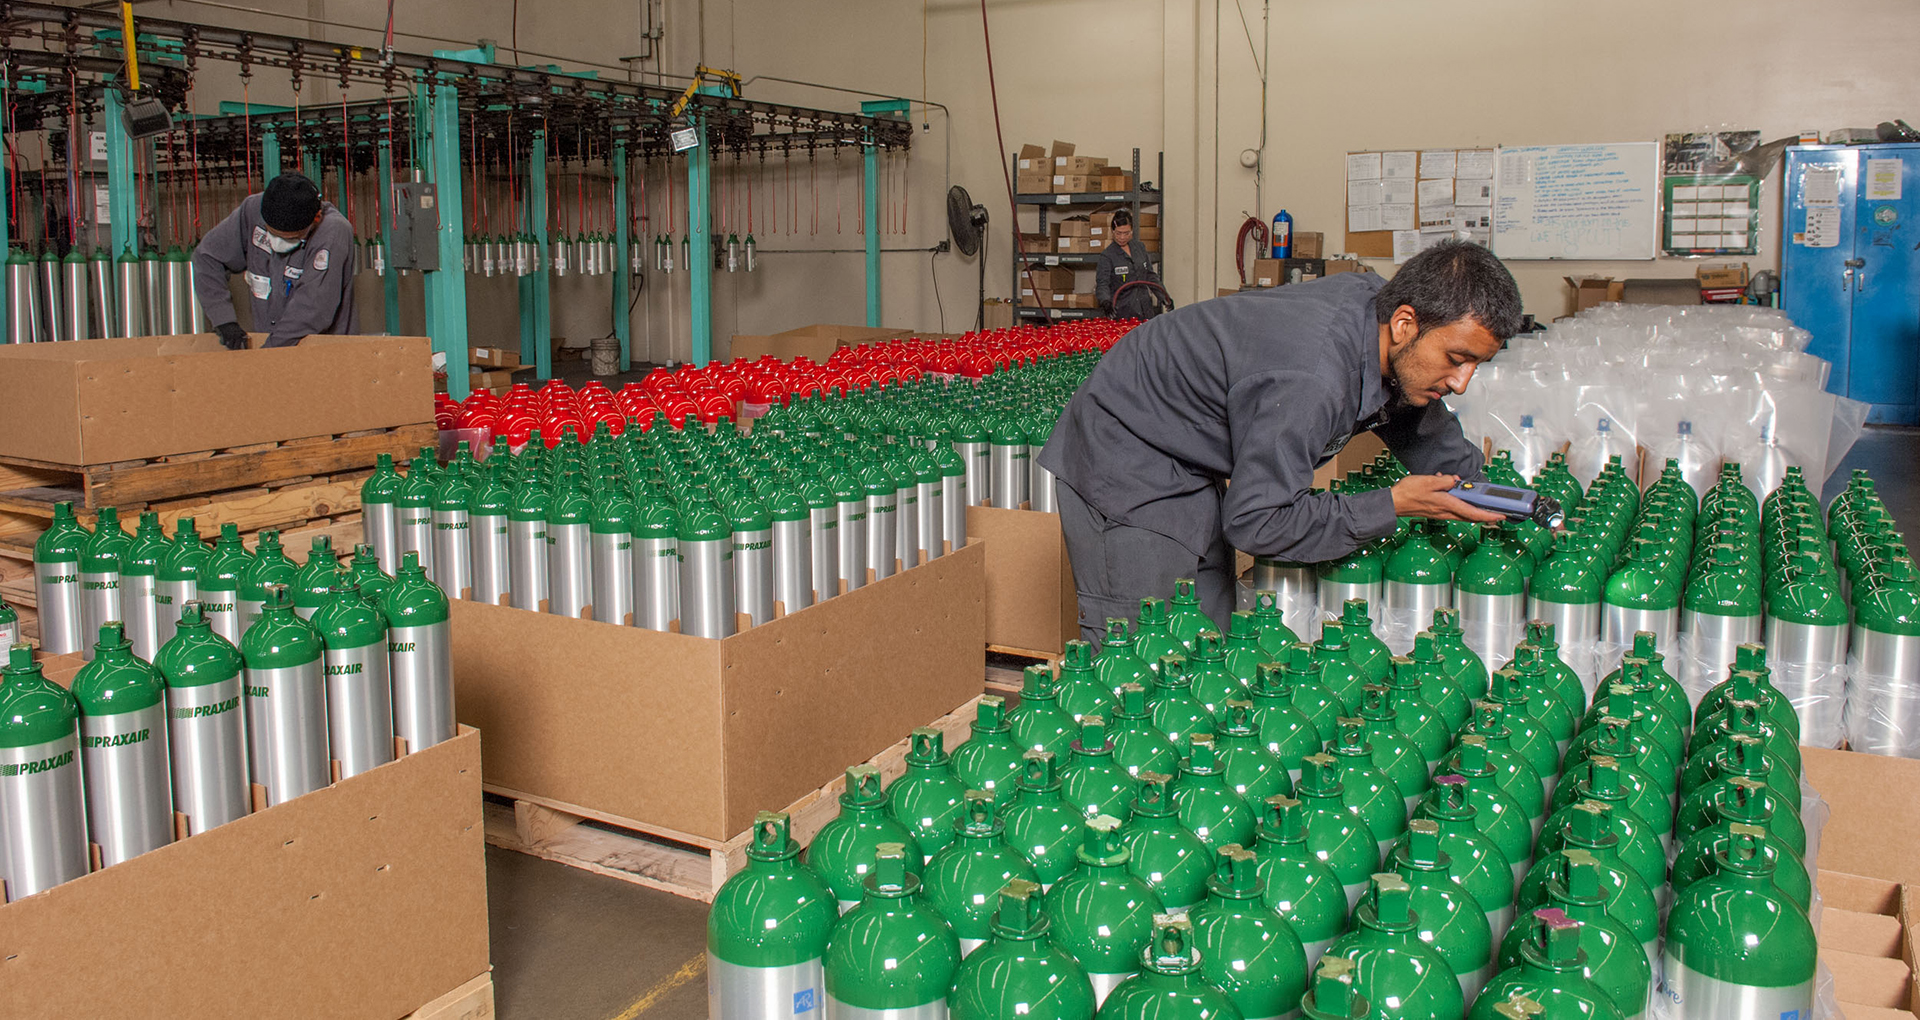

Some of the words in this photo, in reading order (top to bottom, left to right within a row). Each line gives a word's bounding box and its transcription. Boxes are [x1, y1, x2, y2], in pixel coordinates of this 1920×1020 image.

[194, 695, 241, 718] PRAXAIR
[94, 727, 151, 749] PRAXAIR
[20, 750, 74, 776] PRAXAIR
